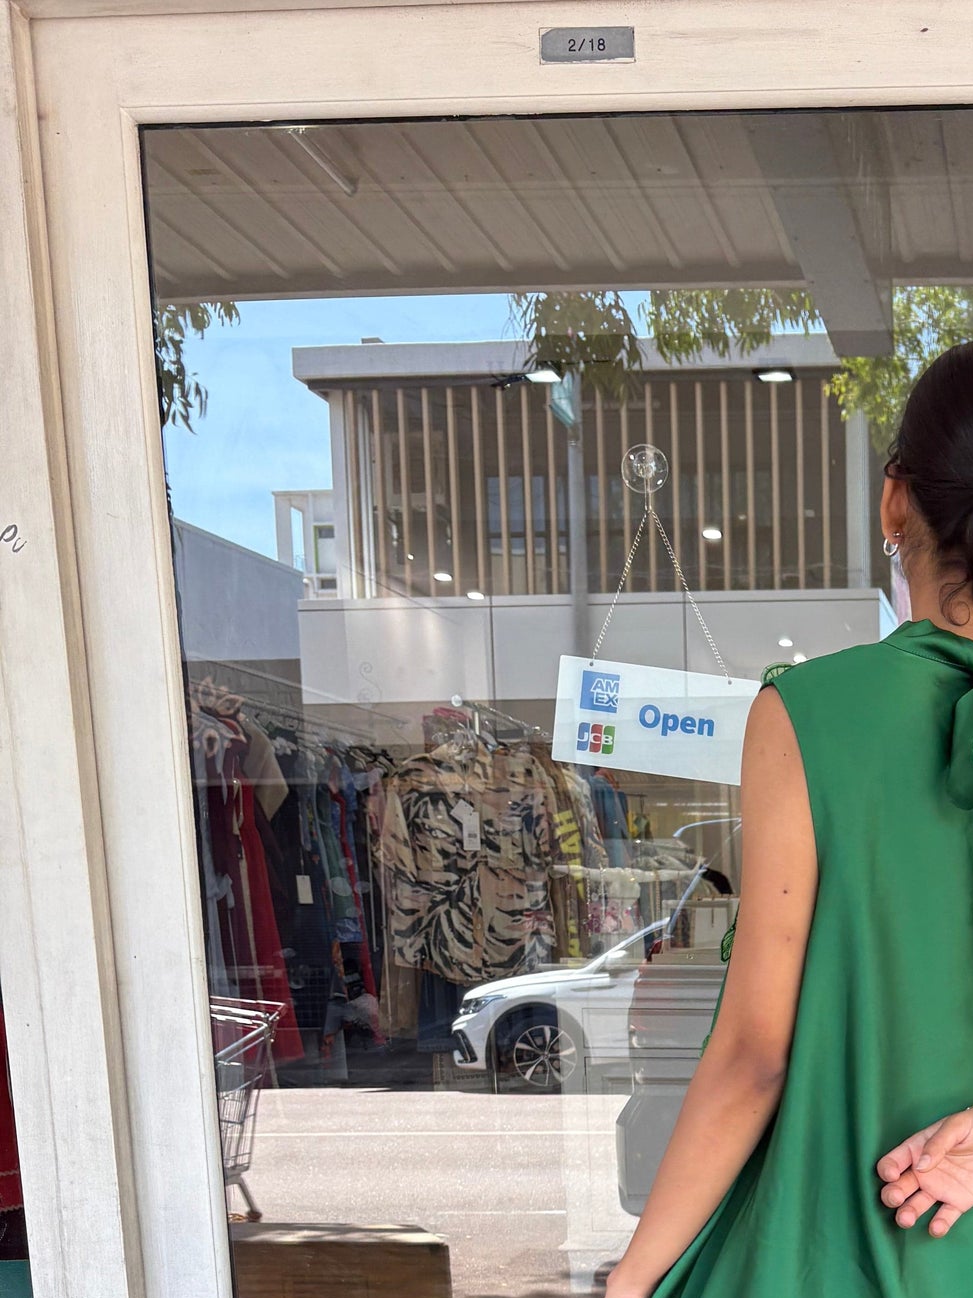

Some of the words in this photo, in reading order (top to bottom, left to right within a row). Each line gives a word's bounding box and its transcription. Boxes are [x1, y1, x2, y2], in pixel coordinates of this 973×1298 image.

[567, 38, 606, 52] 2/18
[638, 704, 715, 737] Open
[577, 731, 614, 746] JCB
